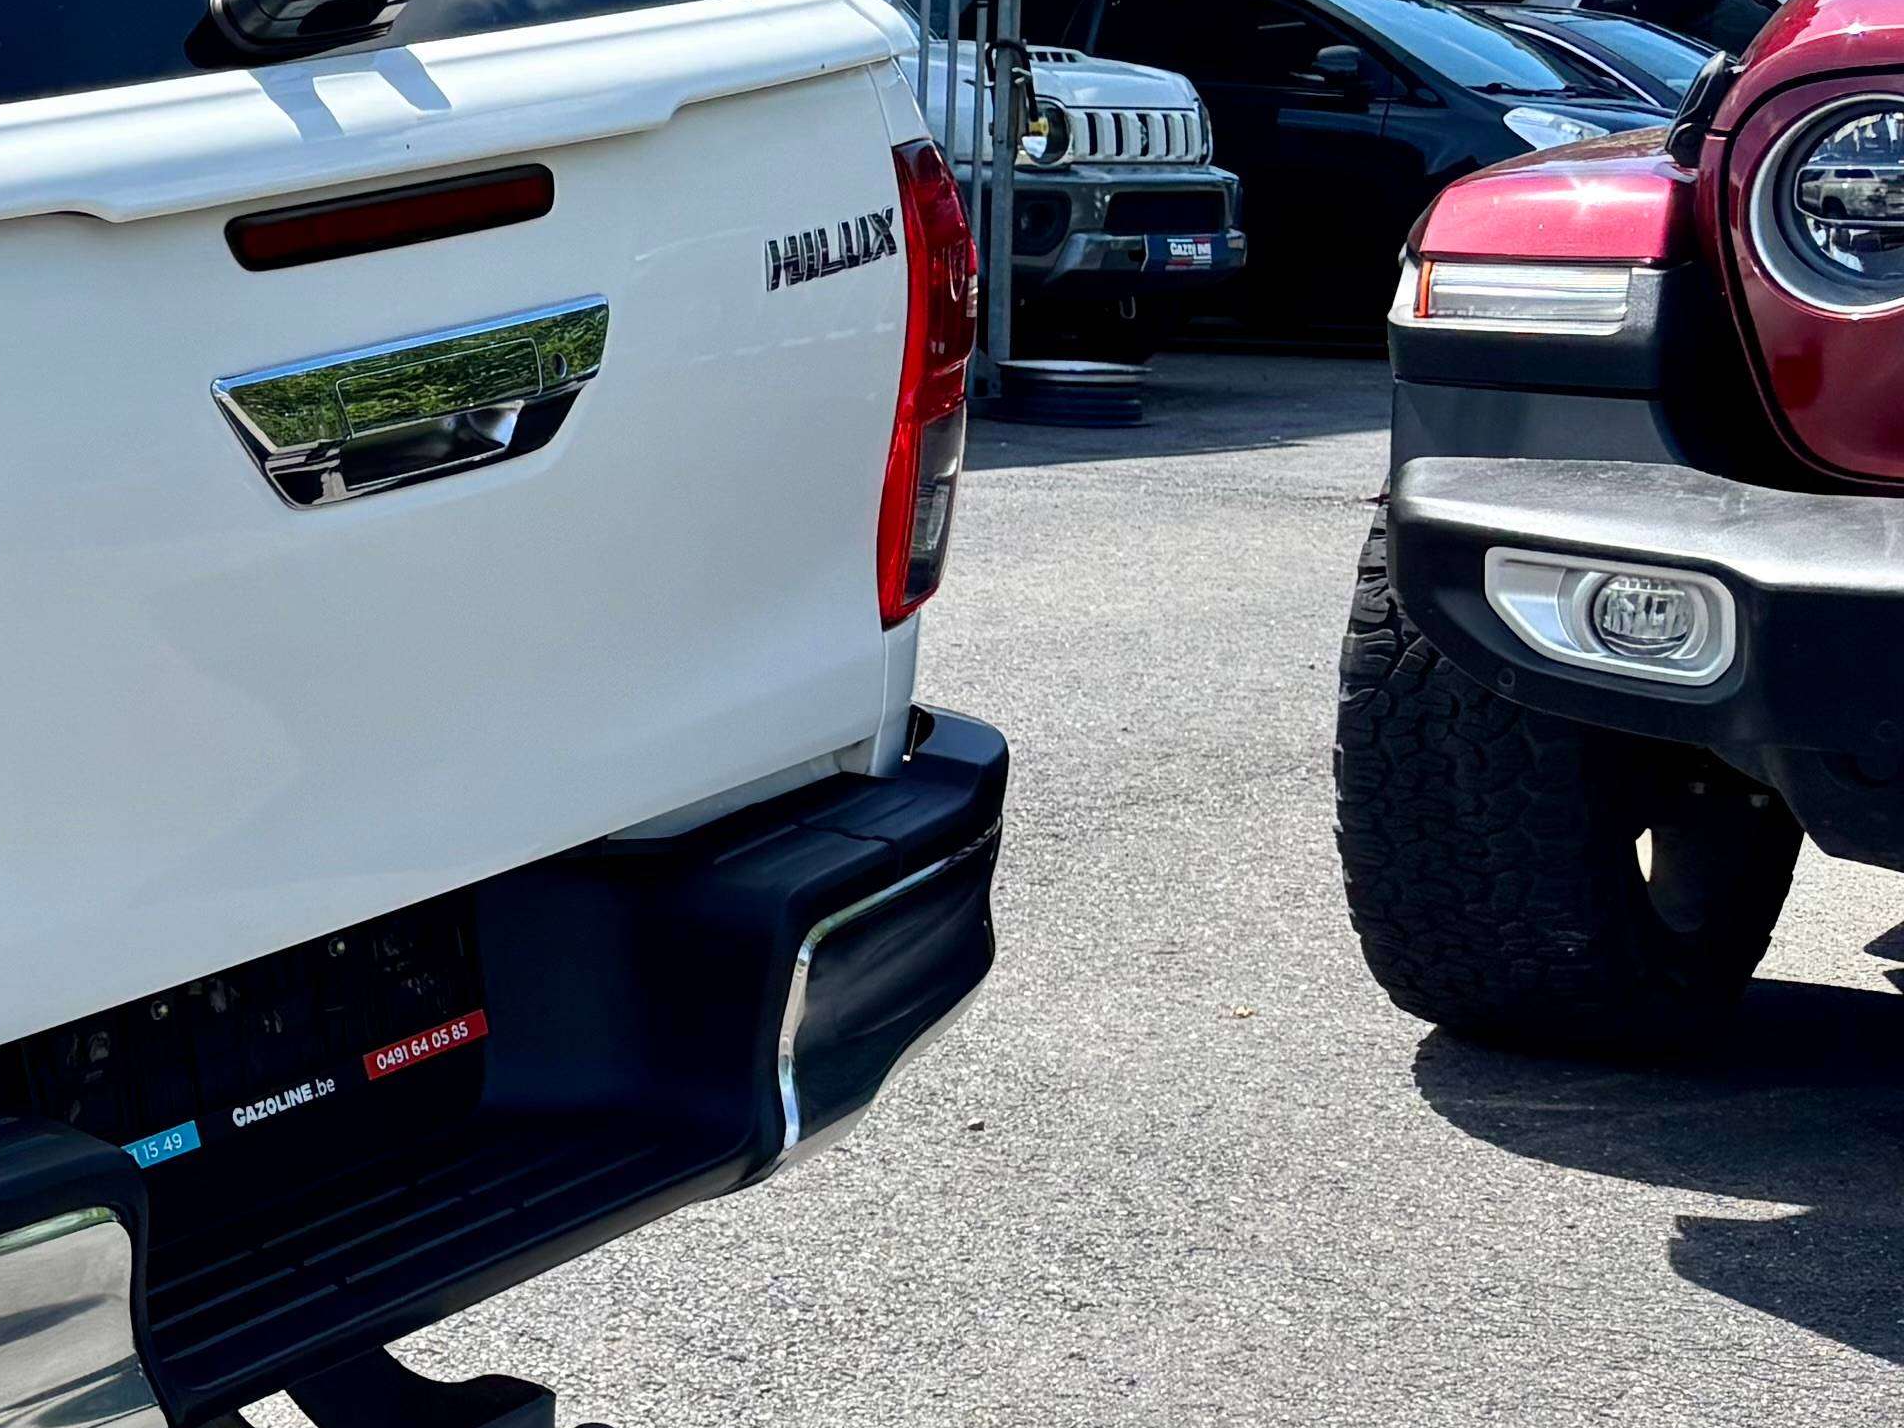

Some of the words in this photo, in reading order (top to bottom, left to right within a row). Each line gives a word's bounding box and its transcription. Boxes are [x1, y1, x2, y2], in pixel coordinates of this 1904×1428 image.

[765, 206, 897, 292] HILUX
[376, 1044, 409, 1070] 0491
[411, 1037, 429, 1056] 64
[431, 1028, 450, 1048] 05
[451, 1021, 469, 1040] 85
[232, 1078, 336, 1127] GAZOLINE.be
[142, 1141, 159, 1160] 15
[163, 1133, 183, 1152] 49
